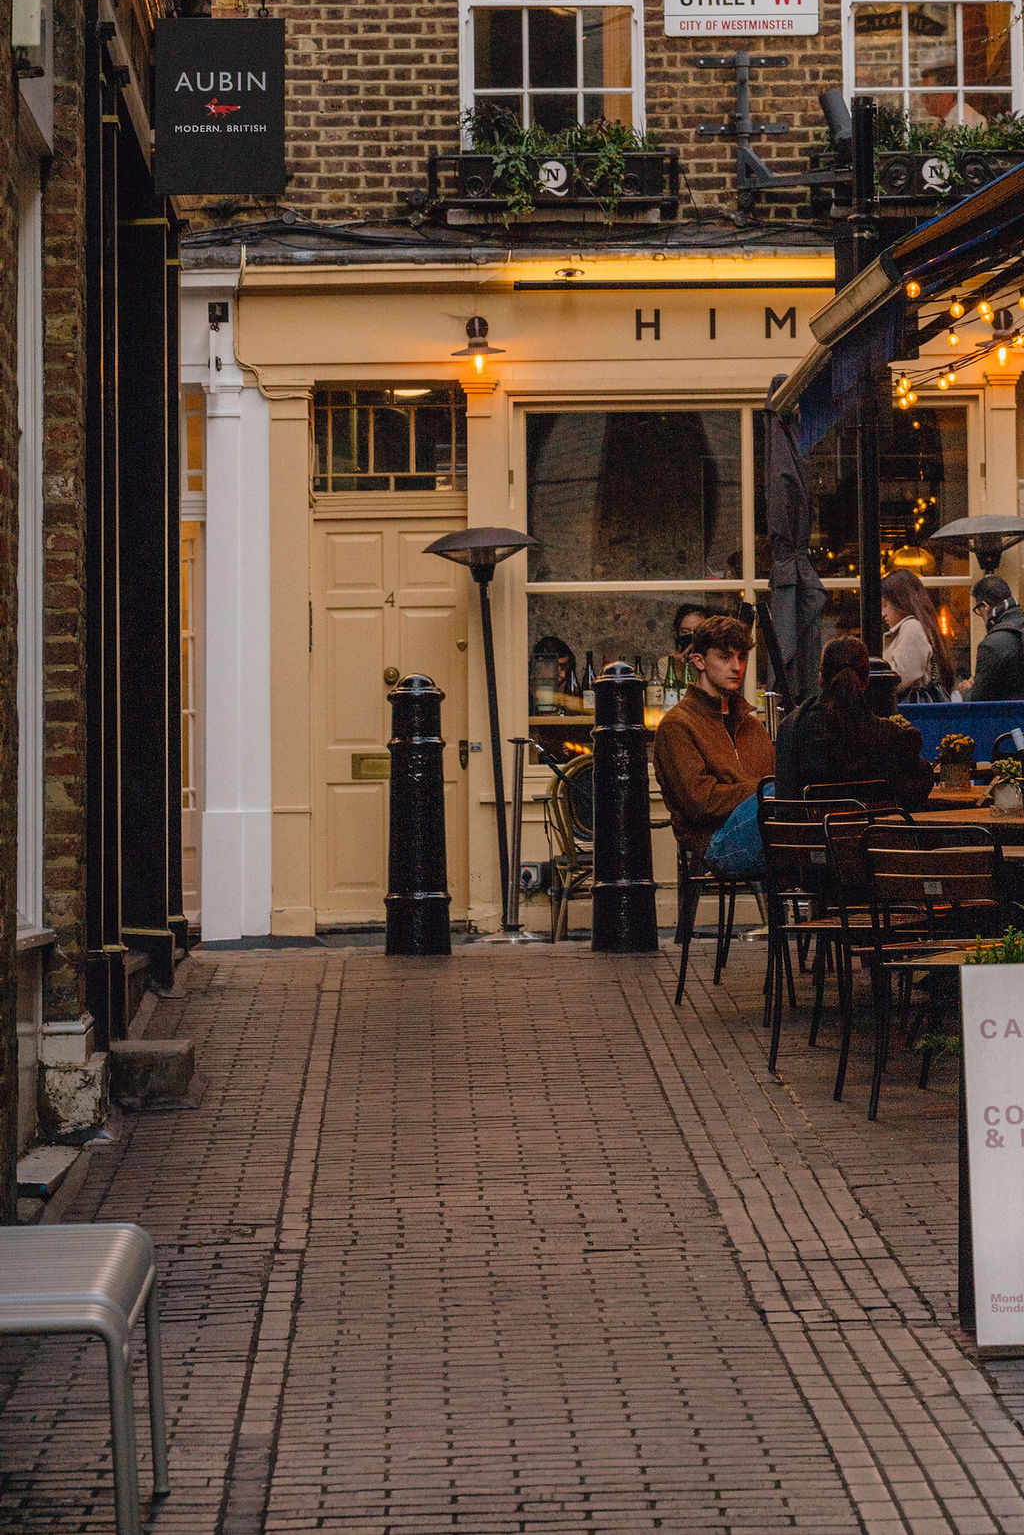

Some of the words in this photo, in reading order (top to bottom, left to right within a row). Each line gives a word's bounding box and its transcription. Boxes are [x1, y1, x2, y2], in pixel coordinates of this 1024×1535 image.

[680, 21, 701, 30] CITY
[706, 21, 717, 30] OF
[722, 20, 793, 30] WESTMINSTER
[174, 71, 267, 92] AUBIN
[174, 125, 222, 133] MODERN.
[227, 124, 267, 133] BRITISH
[384, 591, 395, 607] 4
[984, 1128, 1005, 1149] &
